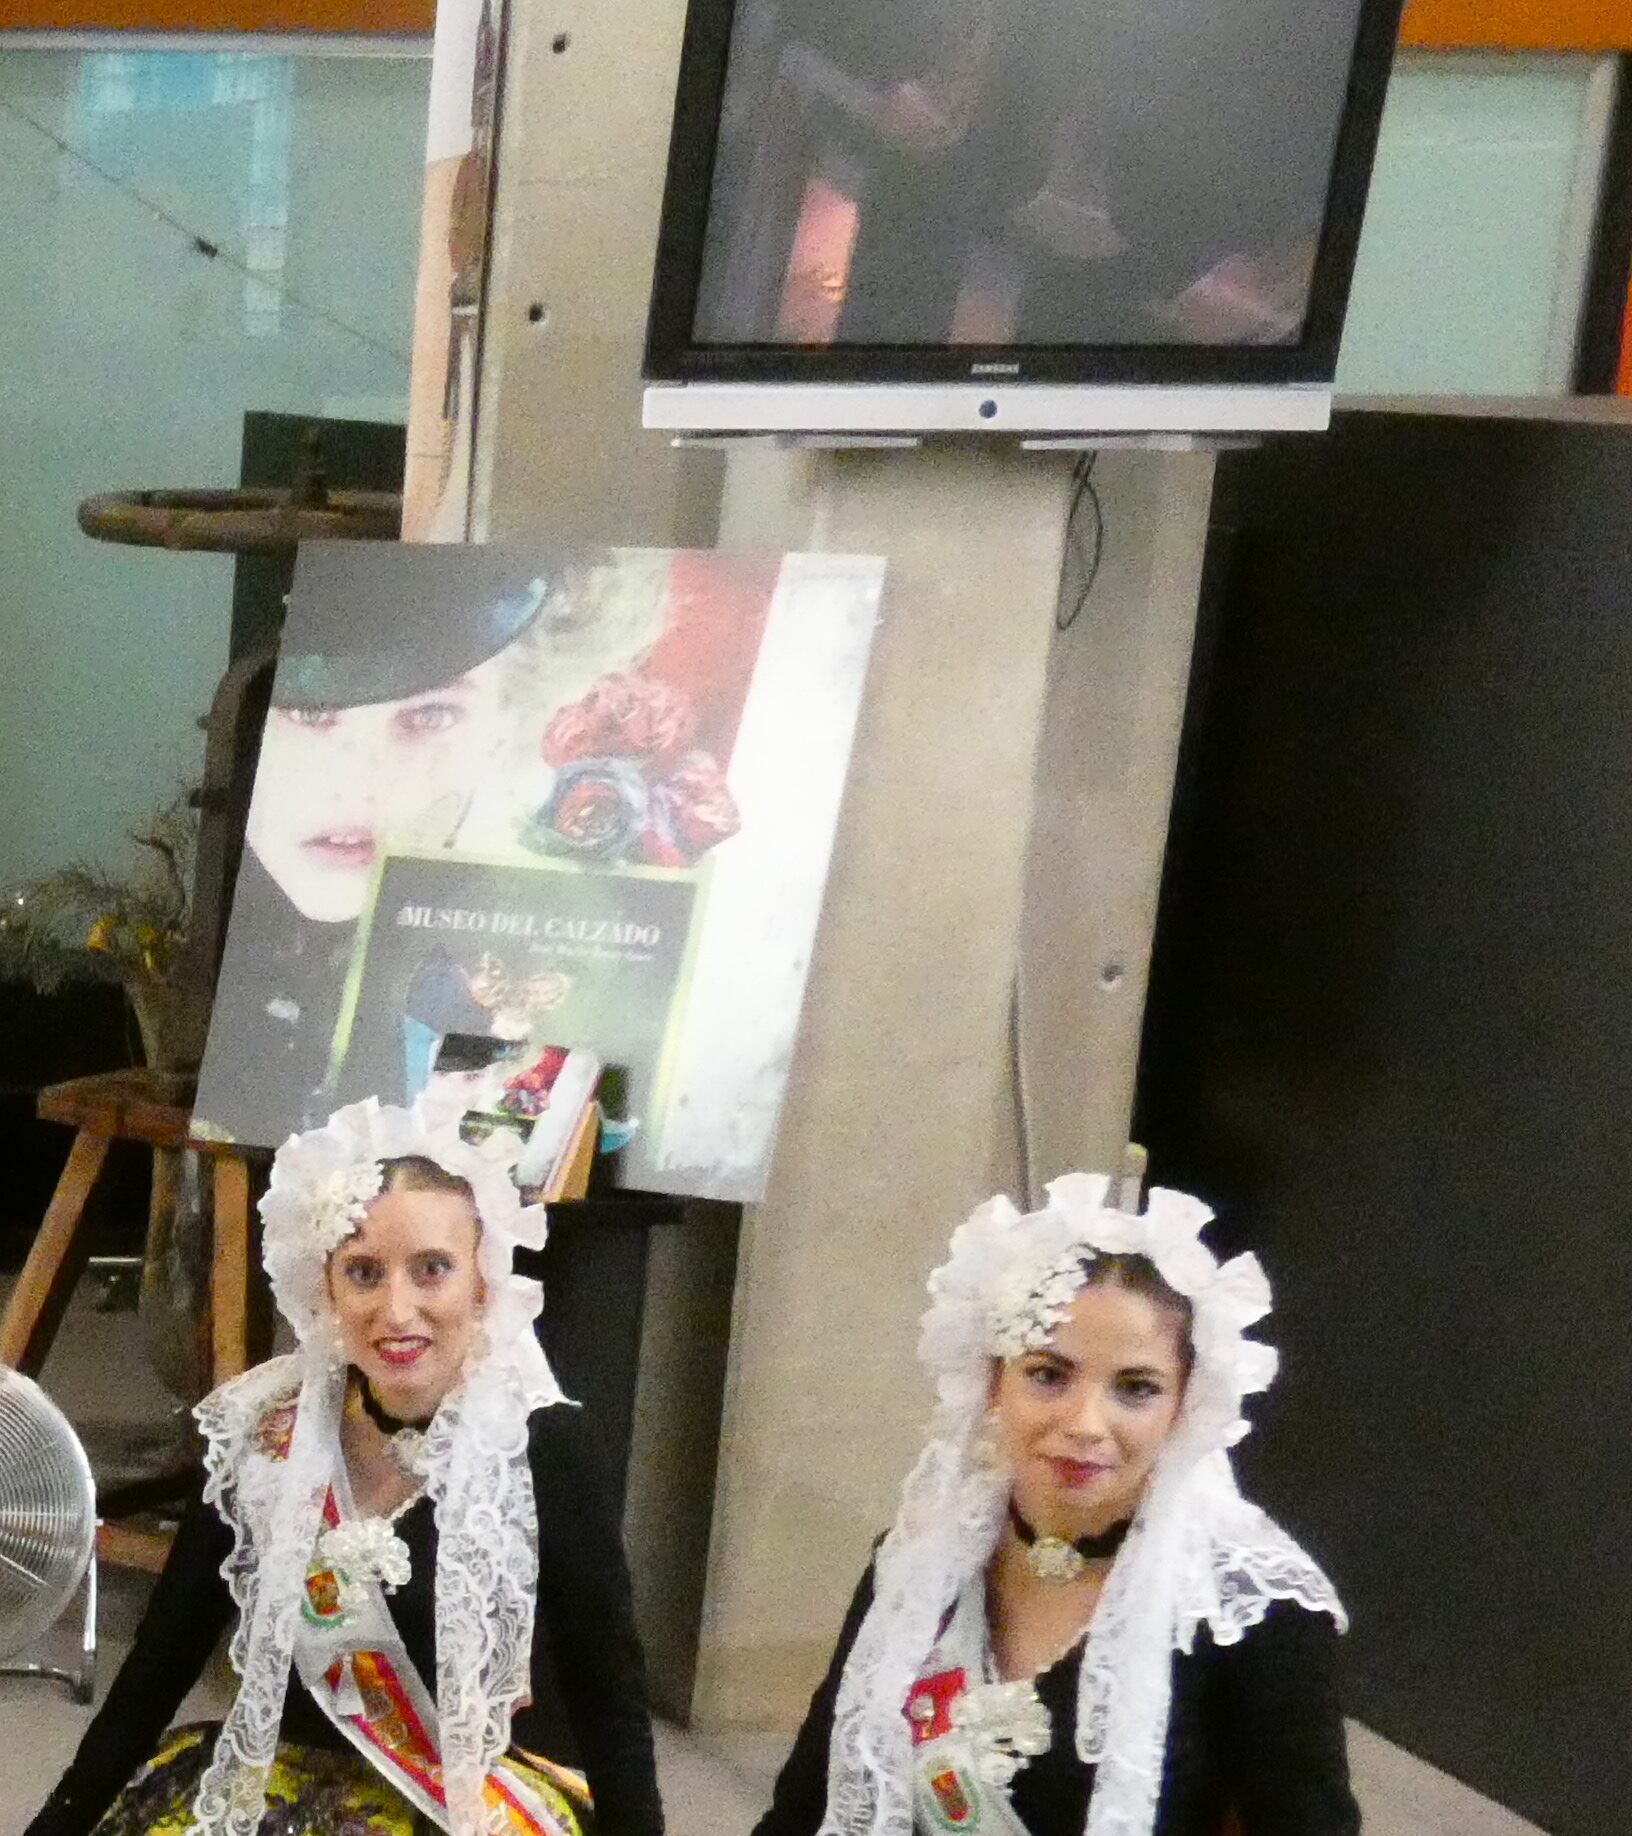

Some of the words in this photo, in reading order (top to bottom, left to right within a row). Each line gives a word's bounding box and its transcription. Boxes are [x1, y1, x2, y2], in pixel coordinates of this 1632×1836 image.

[396, 905, 486, 932] MUSEO
[490, 912, 538, 936] DEL
[543, 917, 662, 947] CALZADO
